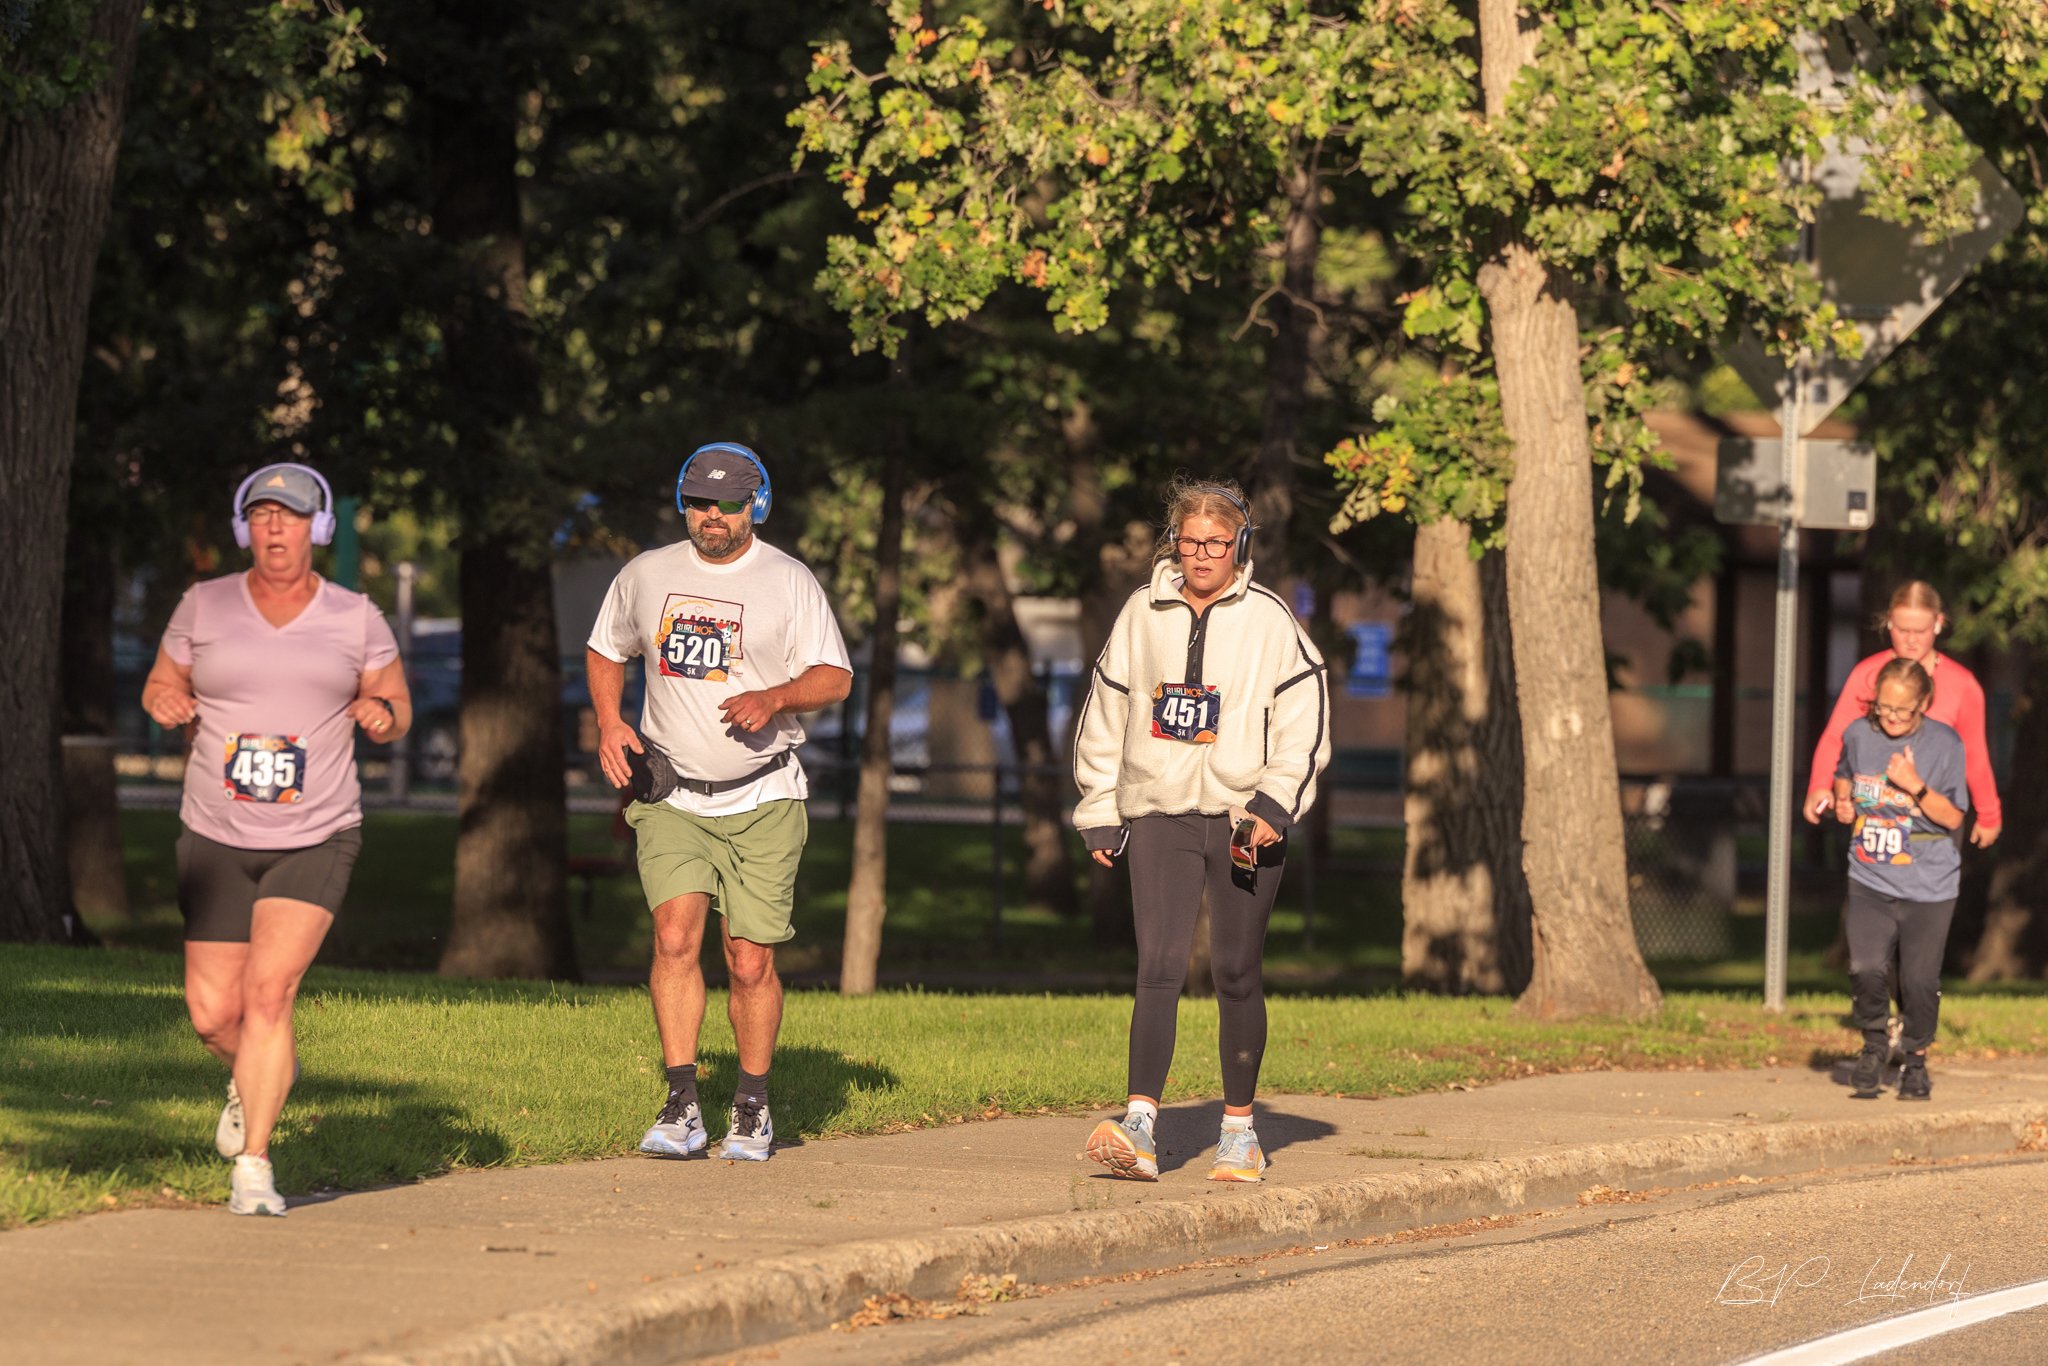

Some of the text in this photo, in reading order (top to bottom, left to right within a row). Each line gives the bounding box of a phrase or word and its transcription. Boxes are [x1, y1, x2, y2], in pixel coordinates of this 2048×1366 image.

[667, 633, 721, 668] 520
[687, 667, 696, 676] 5K
[1161, 697, 1209, 728] 451
[1177, 728, 1186, 736] 5K
[231, 750, 296, 788] 435
[1862, 826, 1902, 854] 579
